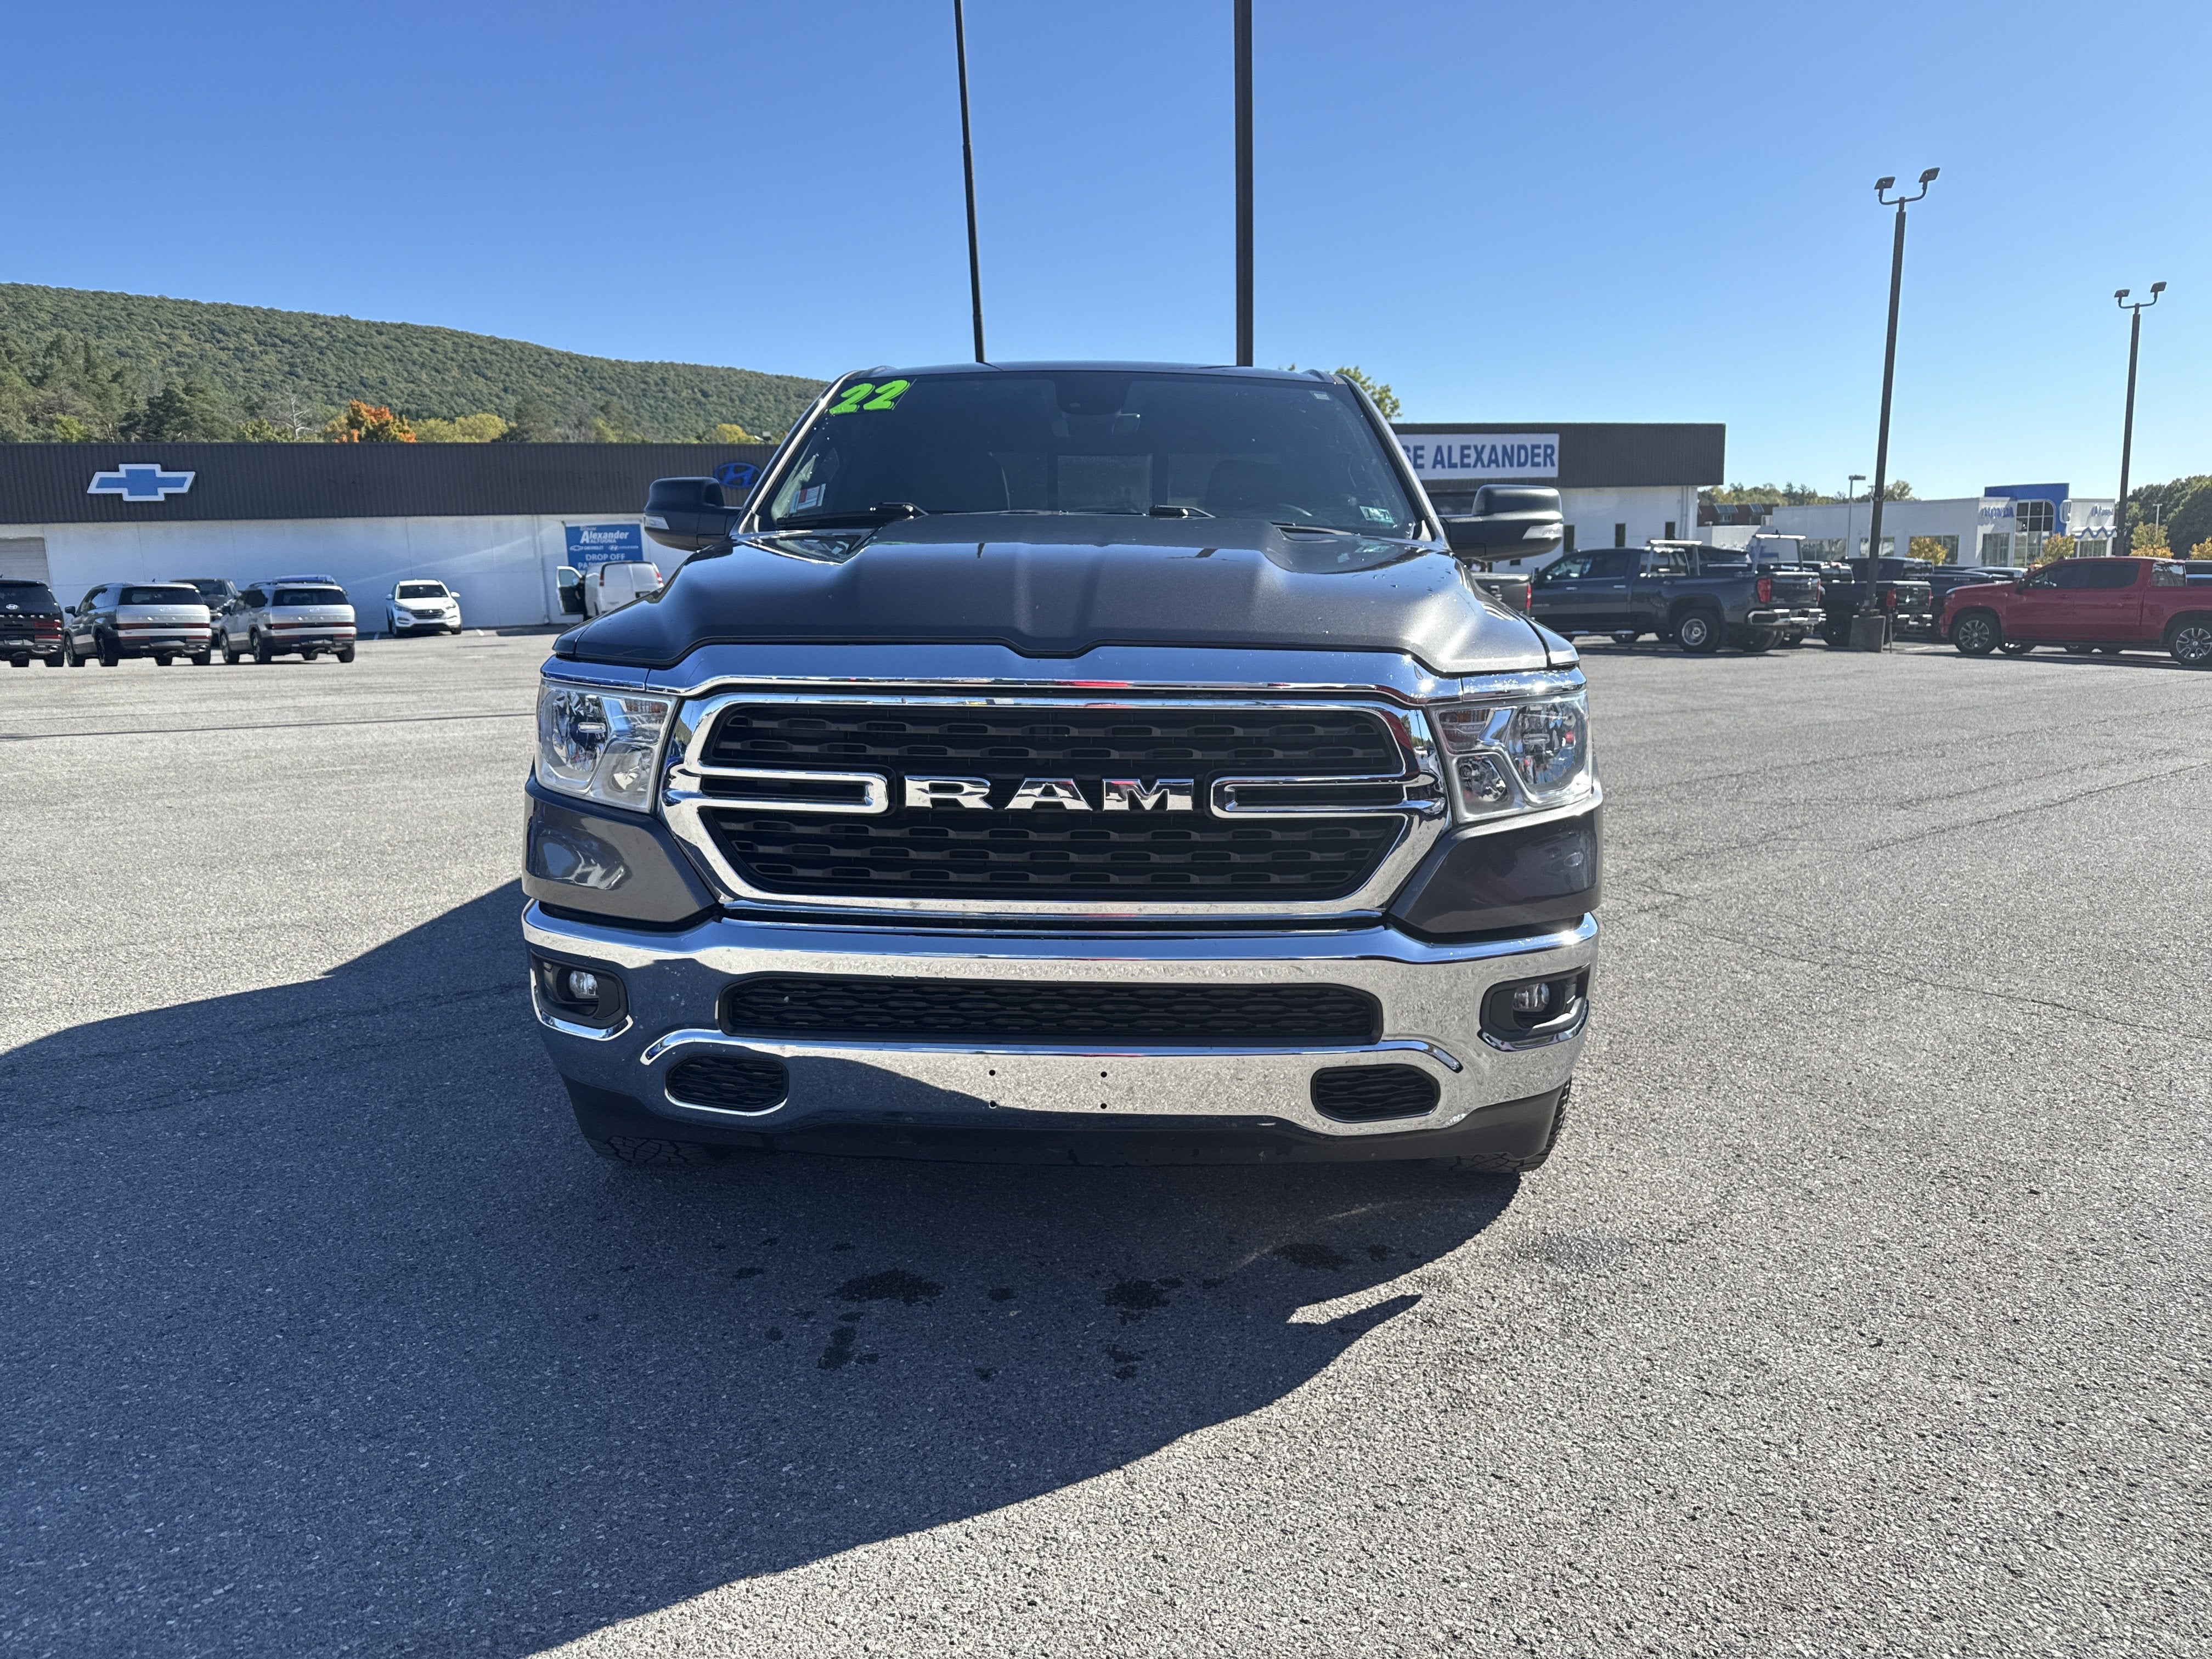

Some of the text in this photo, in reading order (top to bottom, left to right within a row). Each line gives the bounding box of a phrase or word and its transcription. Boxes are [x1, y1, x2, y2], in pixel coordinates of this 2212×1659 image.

[829, 380, 910, 415] 22
[1432, 444, 1555, 469] ALEXANDER
[580, 530, 629, 543] Alexander
[905, 775, 1194, 810] RAM
